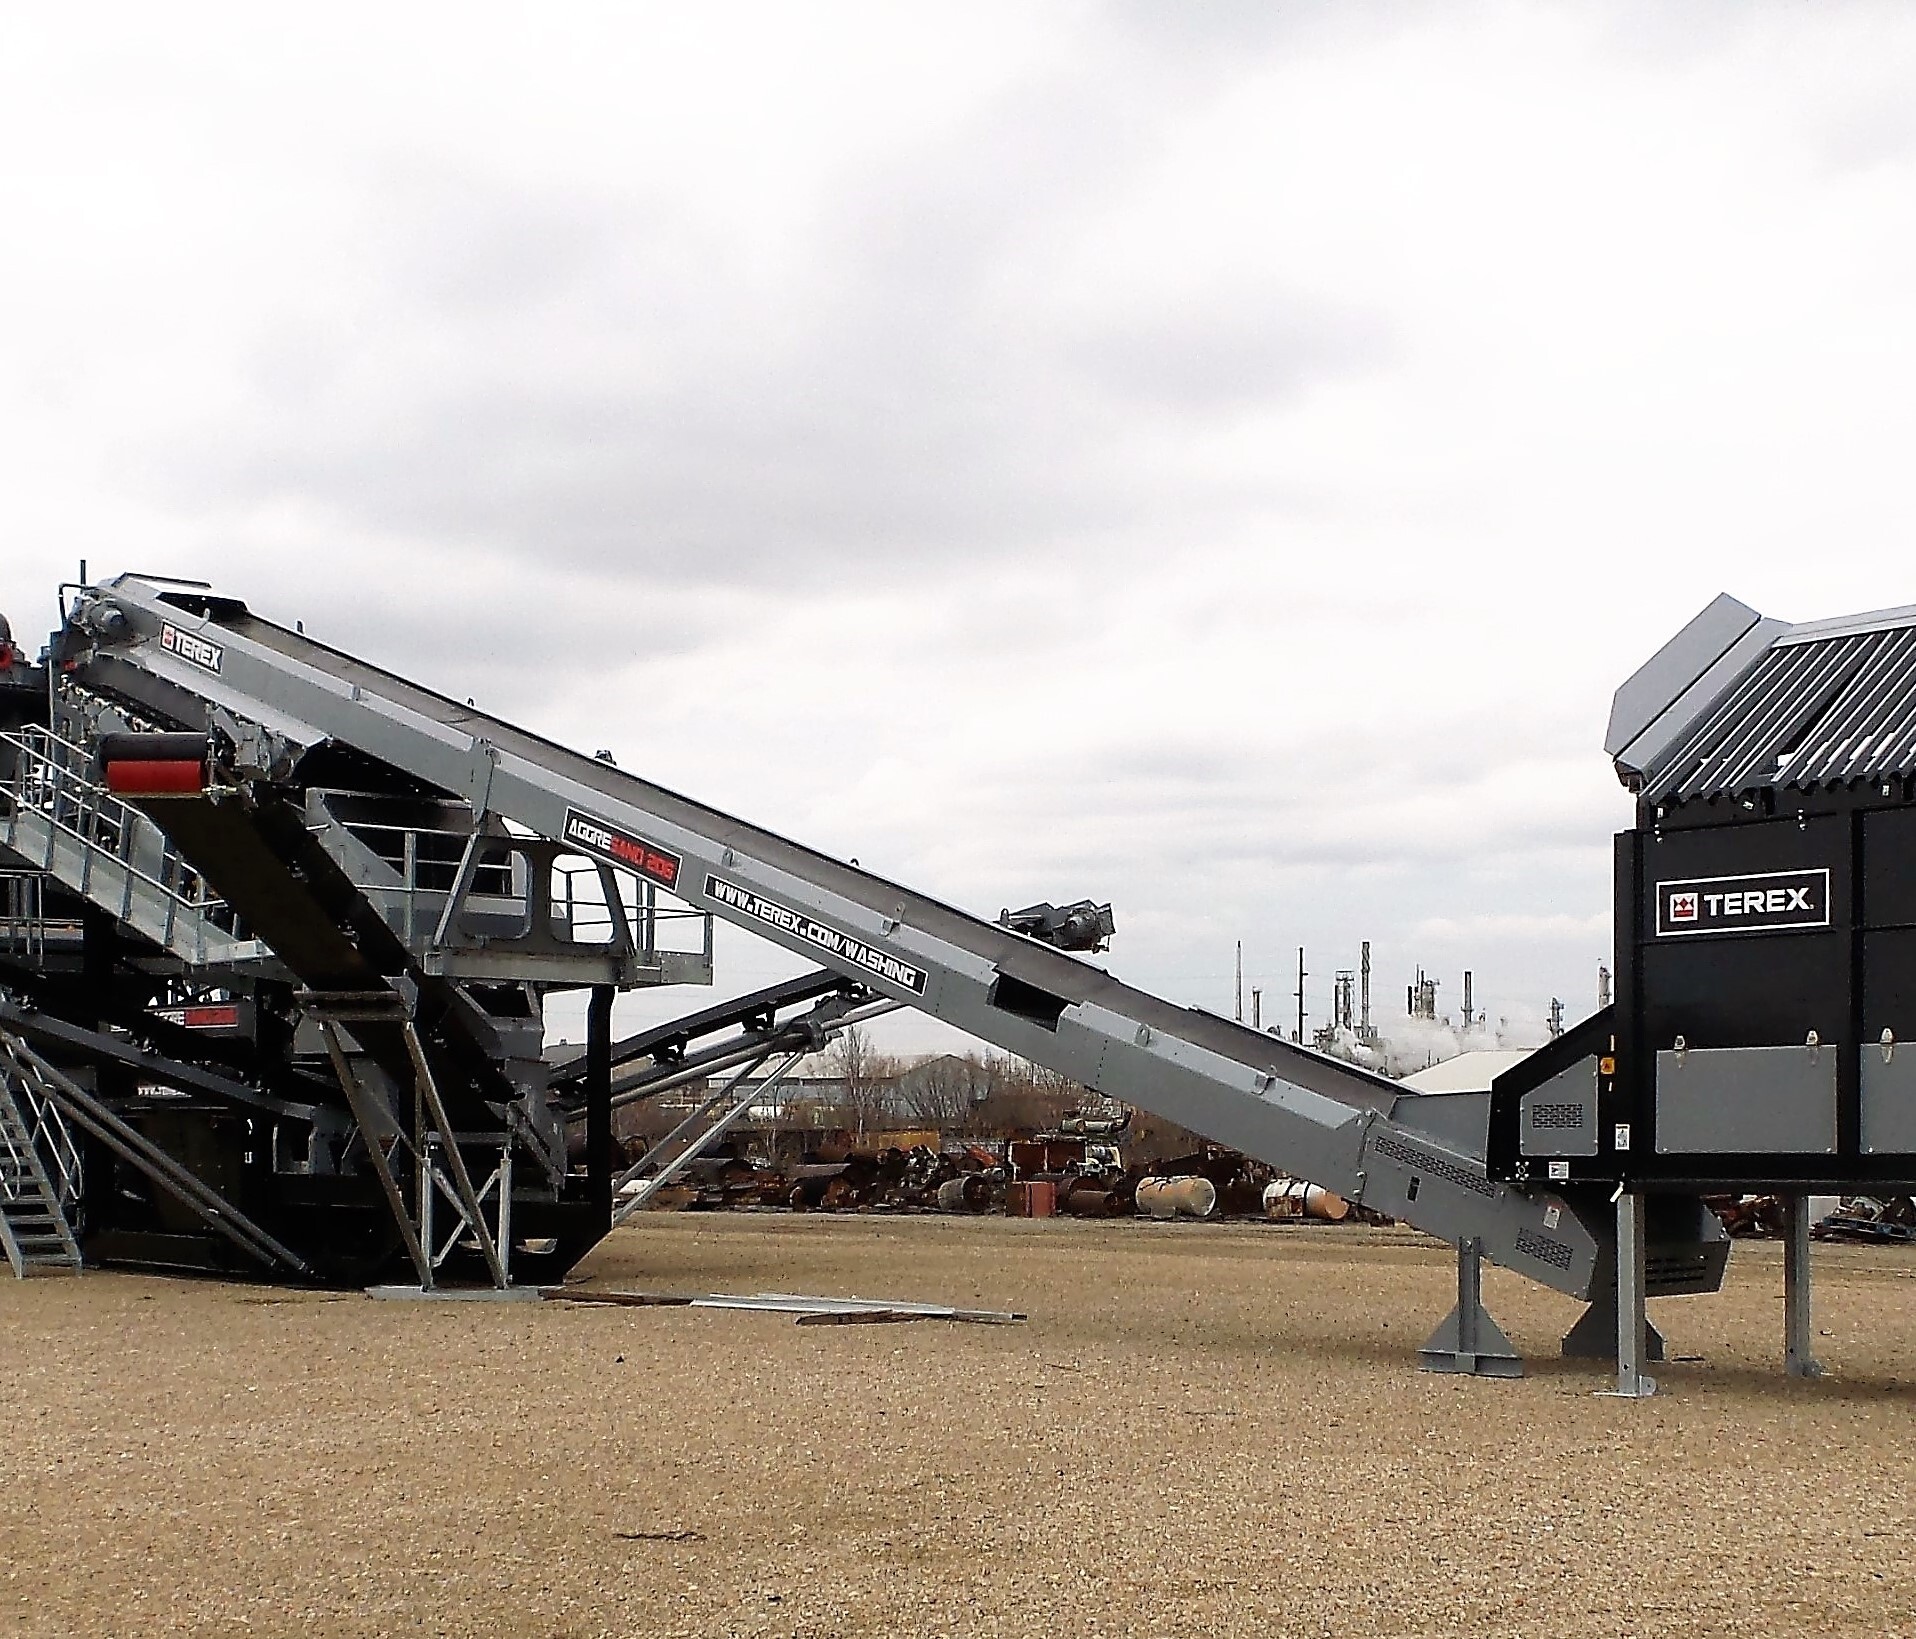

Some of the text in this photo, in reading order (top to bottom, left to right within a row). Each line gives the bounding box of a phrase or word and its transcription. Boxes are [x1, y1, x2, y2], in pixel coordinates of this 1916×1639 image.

[175, 630, 221, 670] TEREX
[1704, 887, 1810, 917] TEREX
[714, 880, 917, 987] WWW.TEREX.COM/WASHING
